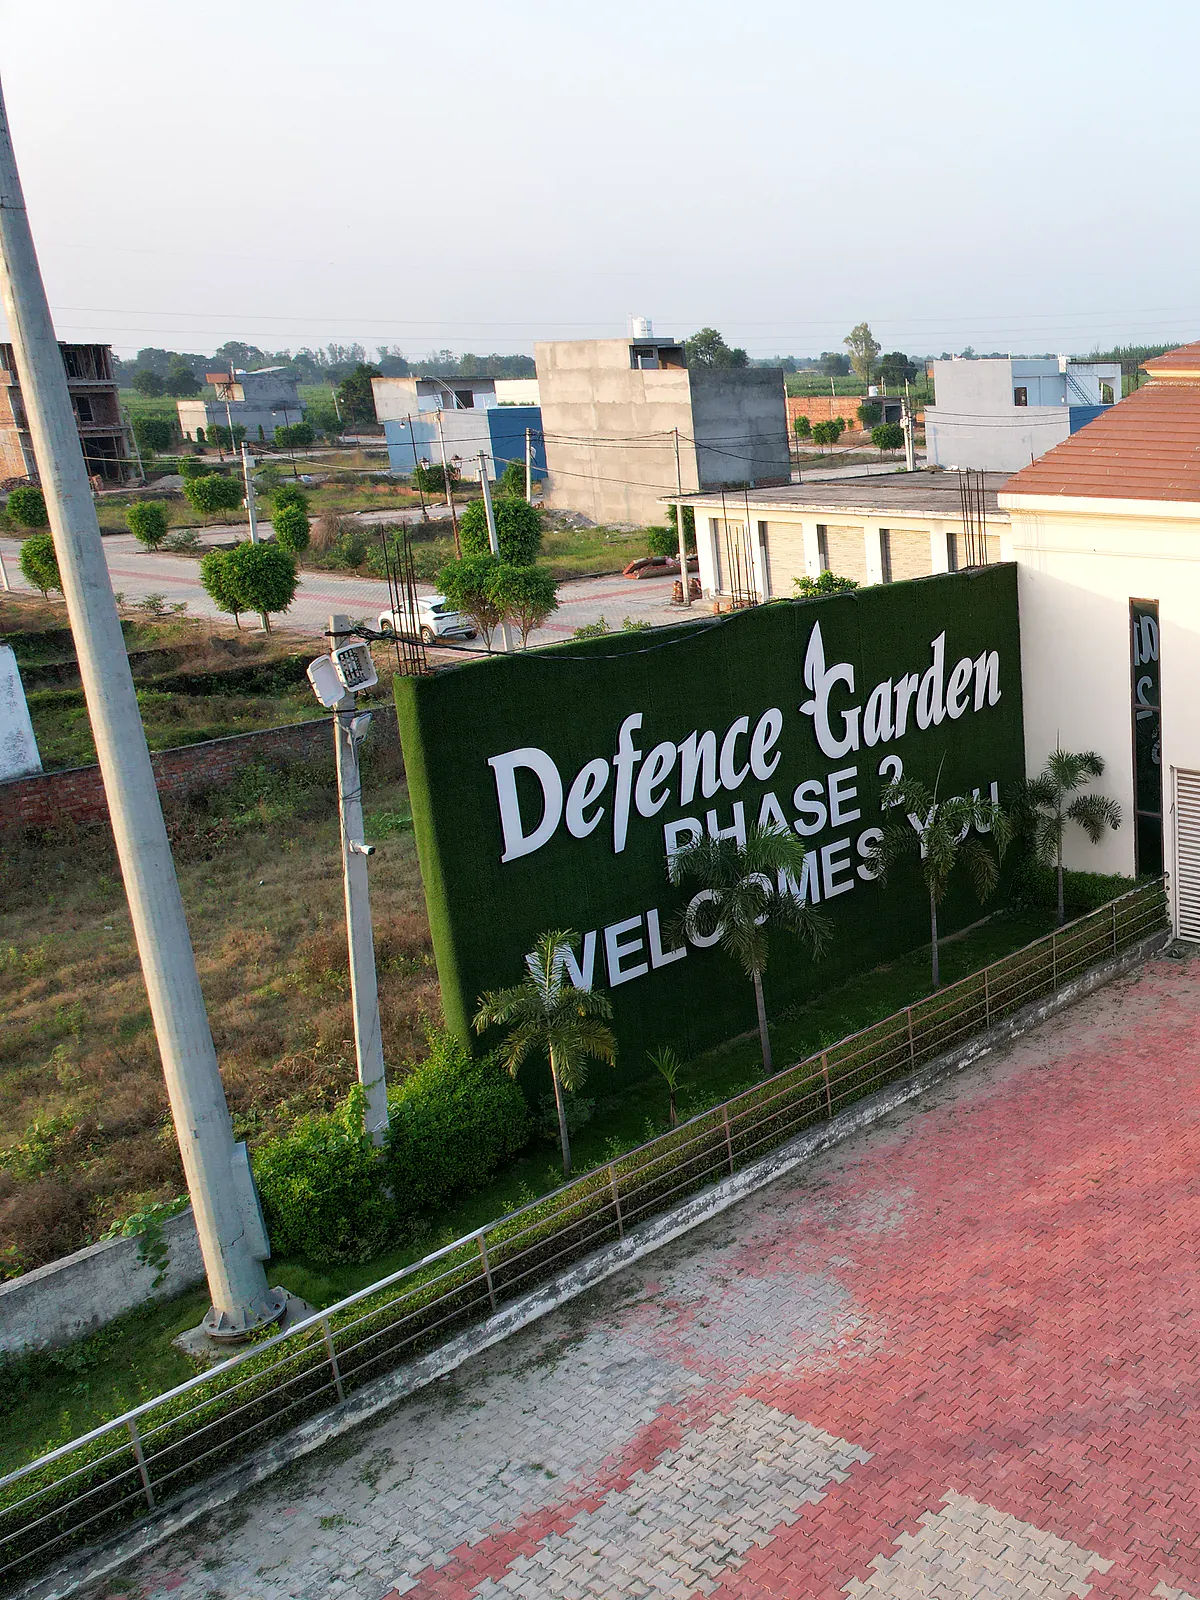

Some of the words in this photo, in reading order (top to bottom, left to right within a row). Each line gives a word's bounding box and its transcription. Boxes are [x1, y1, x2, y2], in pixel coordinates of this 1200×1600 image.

[487, 708, 783, 864] Defence
[797, 620, 1003, 759] Garden
[664, 766, 861, 884] PHASE
[878, 754, 905, 812] 2
